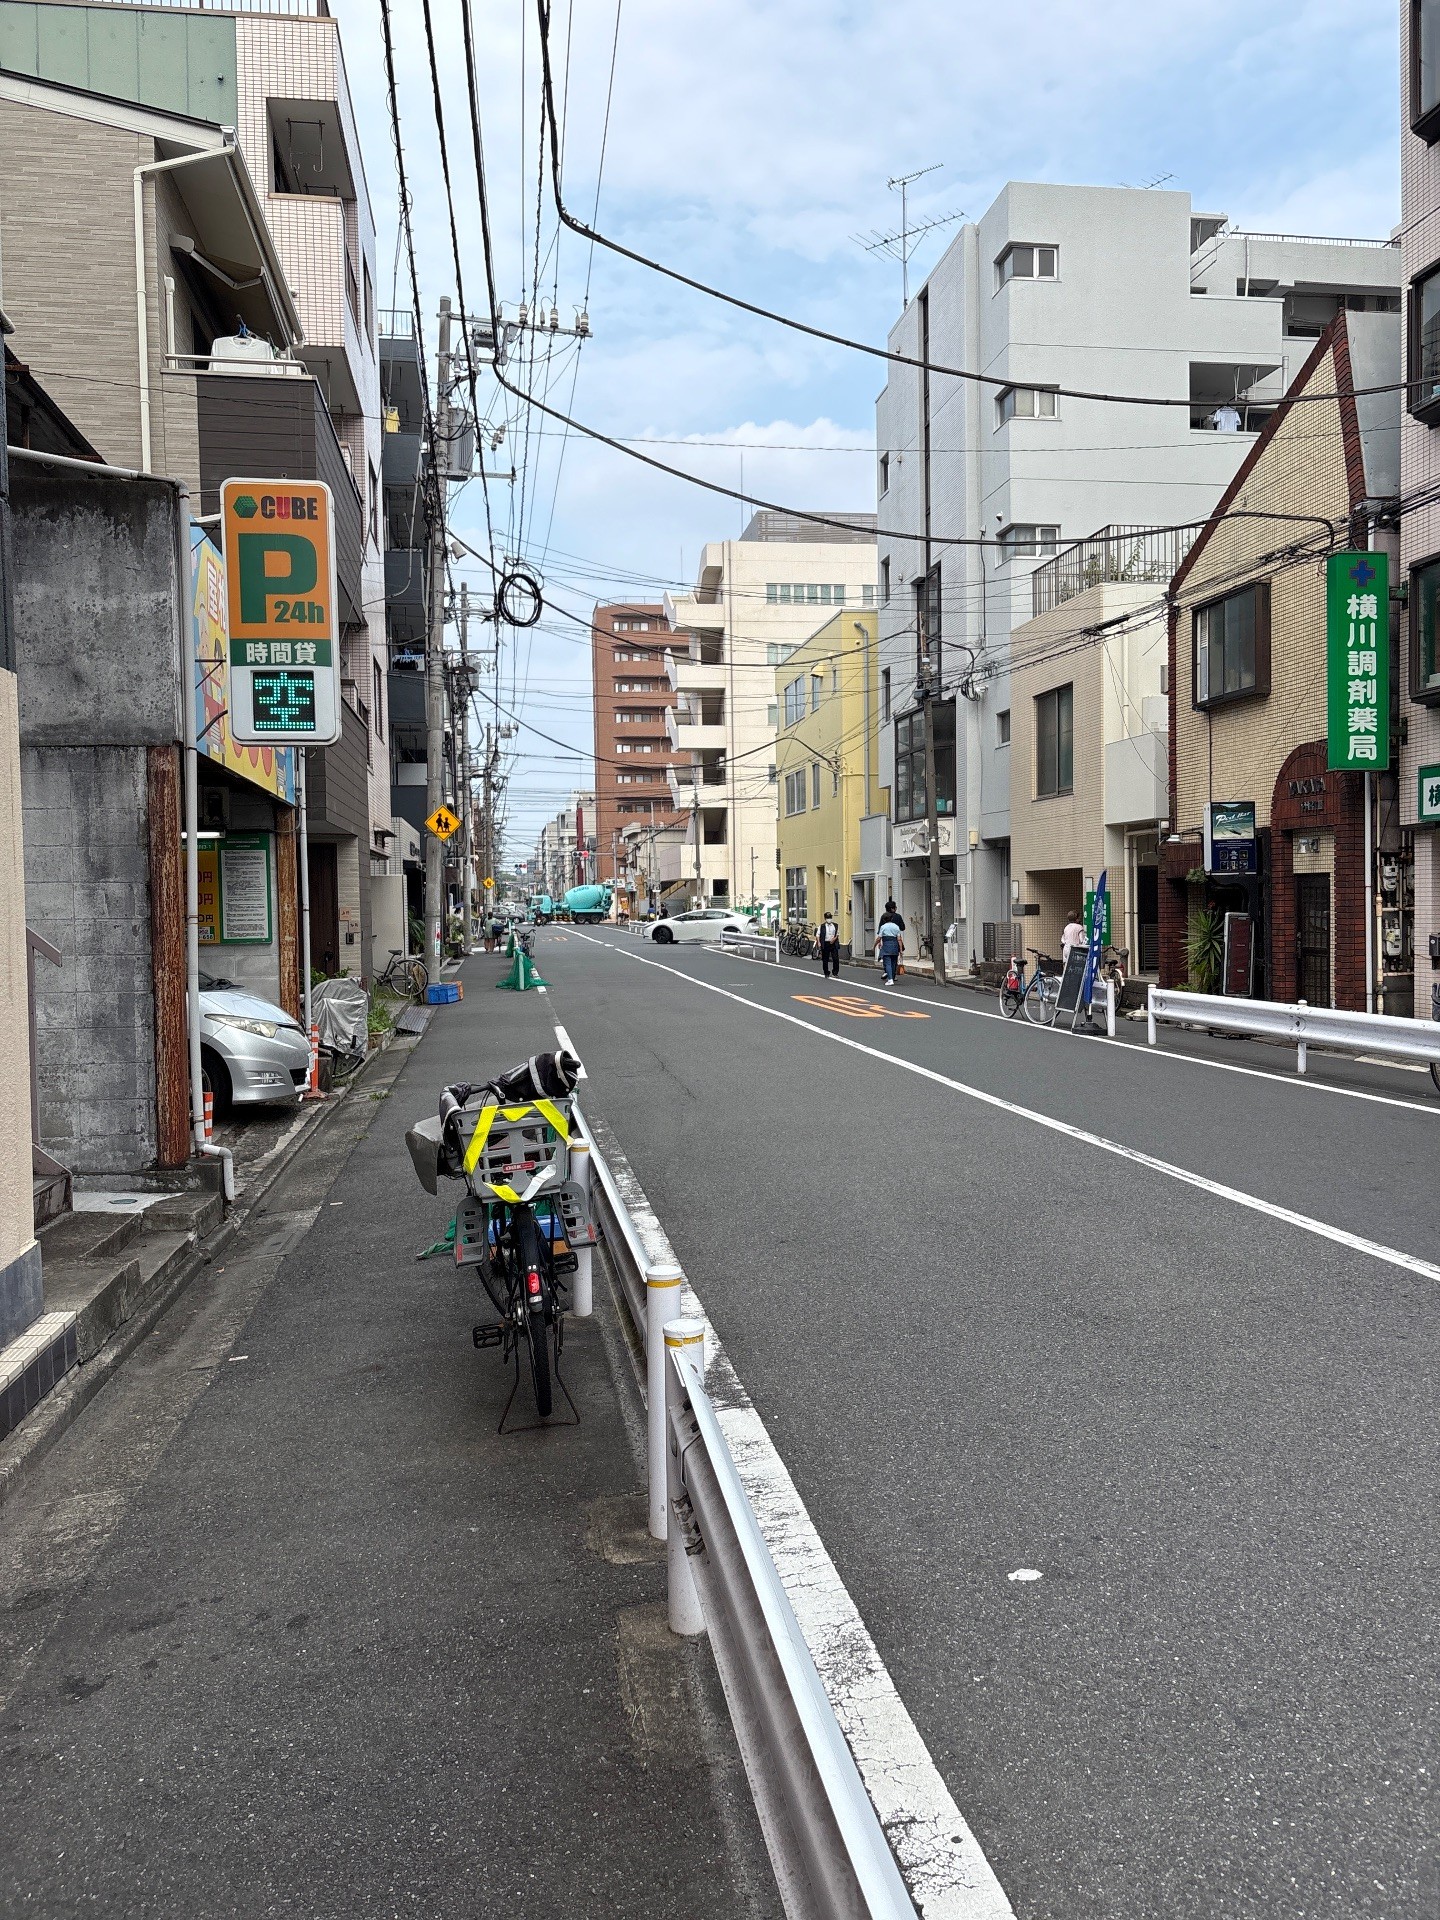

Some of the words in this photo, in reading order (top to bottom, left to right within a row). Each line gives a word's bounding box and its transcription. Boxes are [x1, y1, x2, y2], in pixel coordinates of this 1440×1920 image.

[261, 495, 319, 521] CUBE
[238, 533, 318, 624] P
[274, 600, 325, 624] 24h
[246, 642, 317, 665] 時間貸
[1346, 593, 1378, 761] 横川調剤薬局
[254, 672, 315, 730] 空
